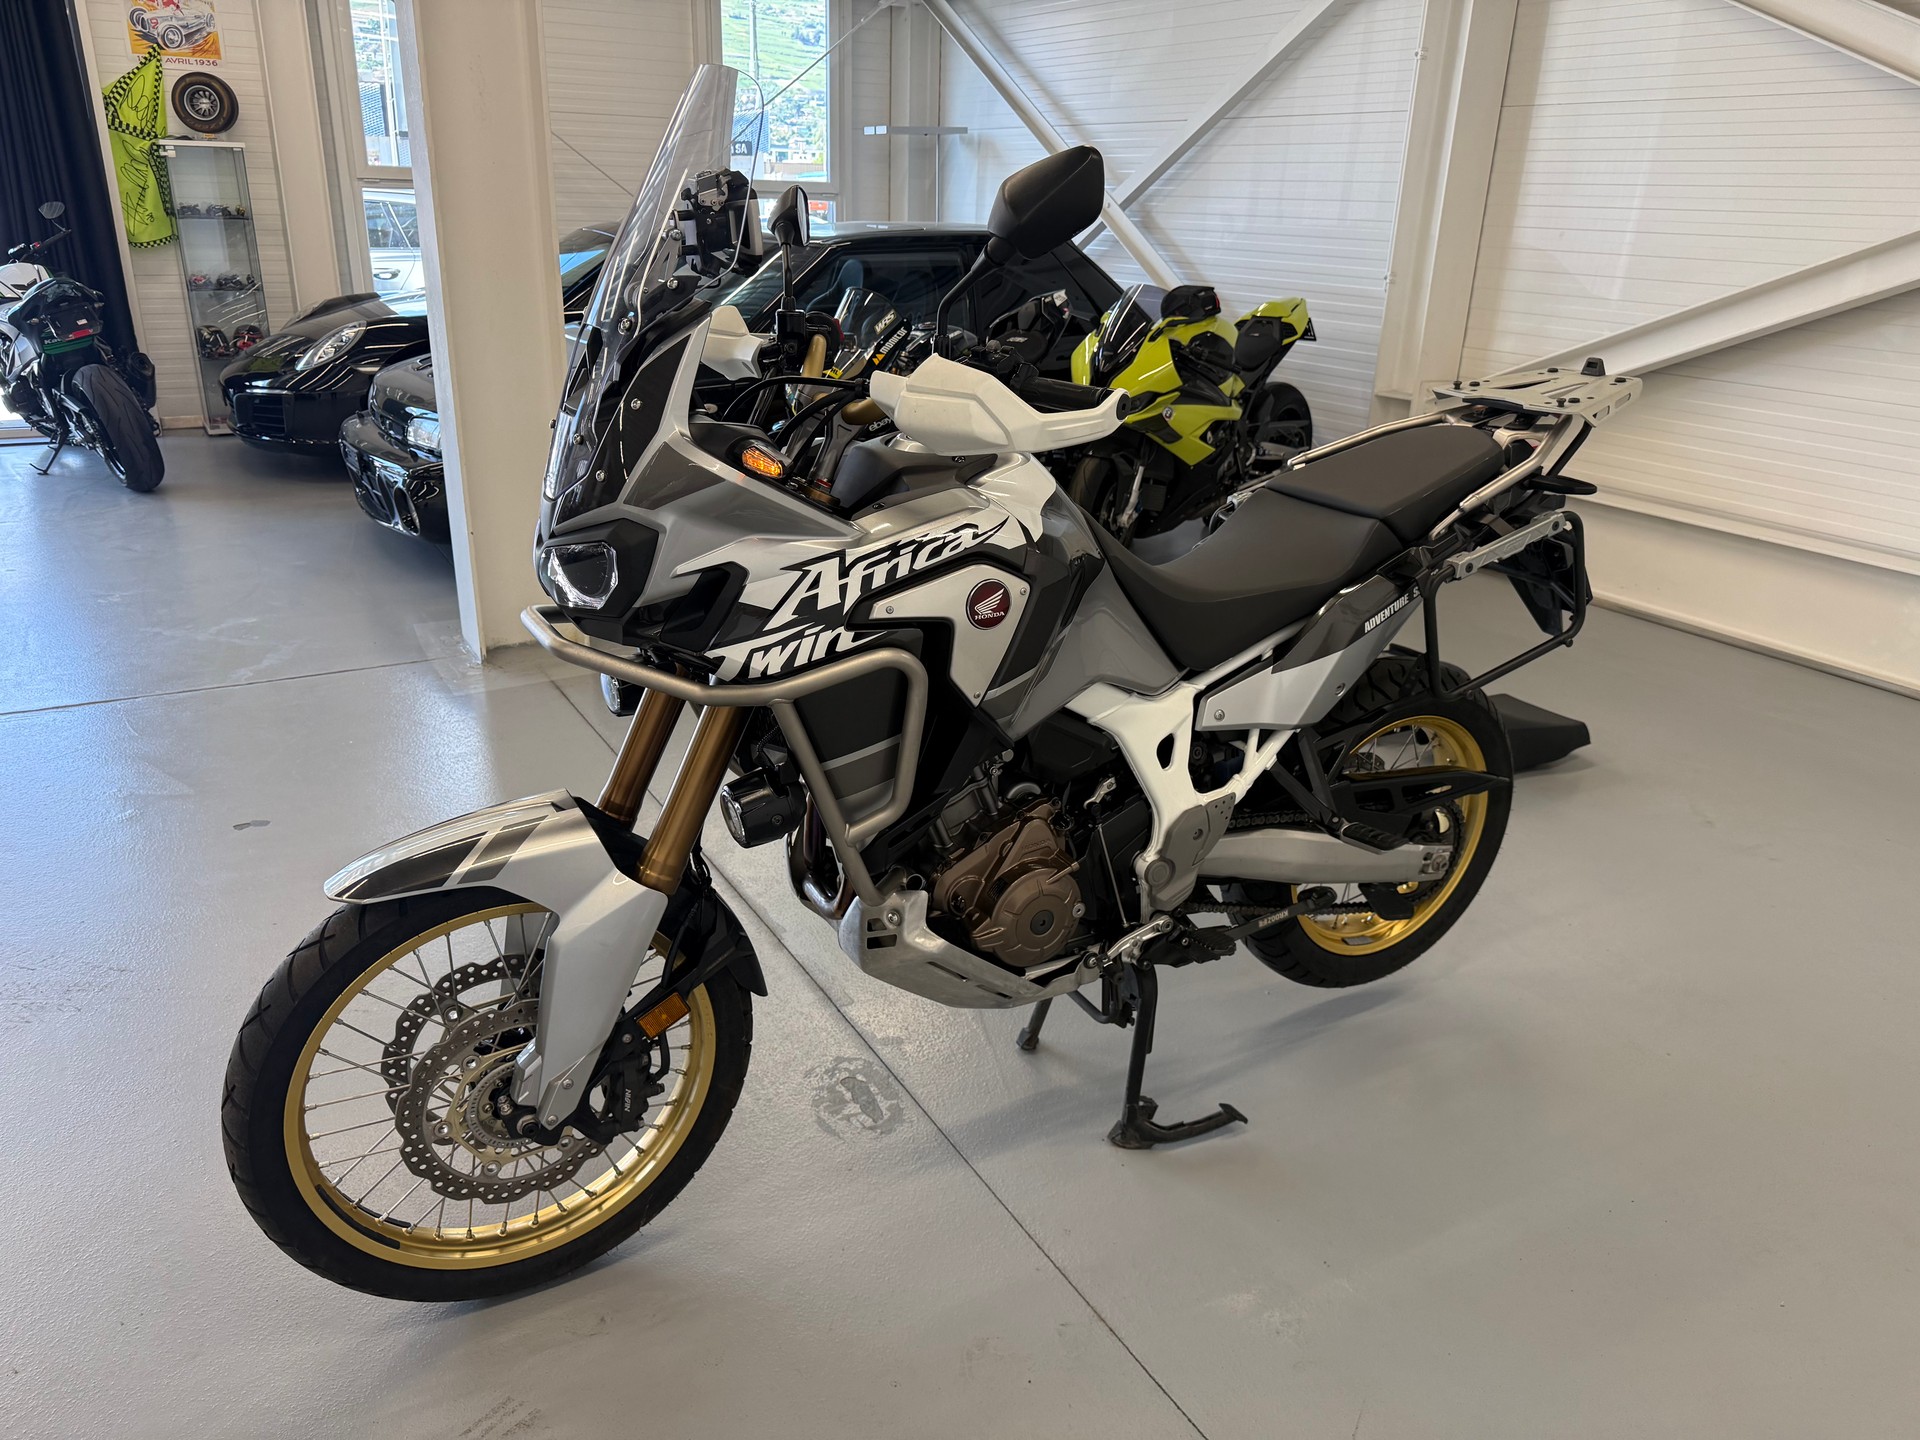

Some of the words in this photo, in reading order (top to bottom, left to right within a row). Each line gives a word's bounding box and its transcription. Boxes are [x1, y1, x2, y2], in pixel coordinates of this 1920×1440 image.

[165, 57, 194, 66] AVRIL
[195, 59, 218, 67] 1936
[735, 143, 747, 154] SA
[875, 310, 896, 333] WRS
[763, 526, 1002, 631] Africa
[974, 611, 1005, 620] HONDA
[1364, 593, 1410, 634] ADVENTURE
[703, 621, 887, 682] Twin
